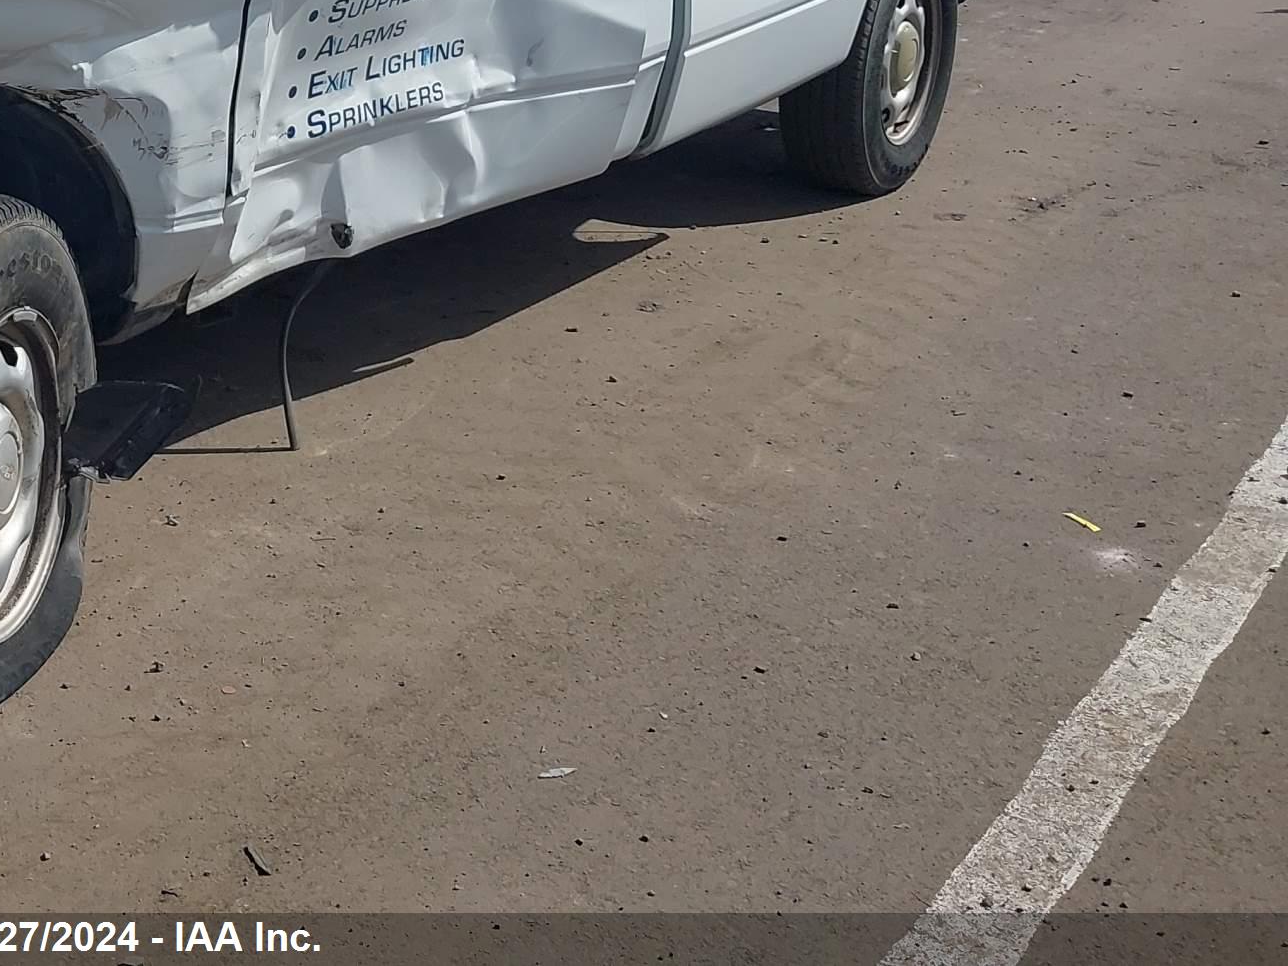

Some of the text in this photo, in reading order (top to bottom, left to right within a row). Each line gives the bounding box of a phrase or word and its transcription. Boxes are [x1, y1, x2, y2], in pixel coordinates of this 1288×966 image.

[306, 38, 465, 99] EXIT LIGHTING
[313, 19, 408, 62] ALARMS
[306, 81, 445, 139] SPRINKLERS
